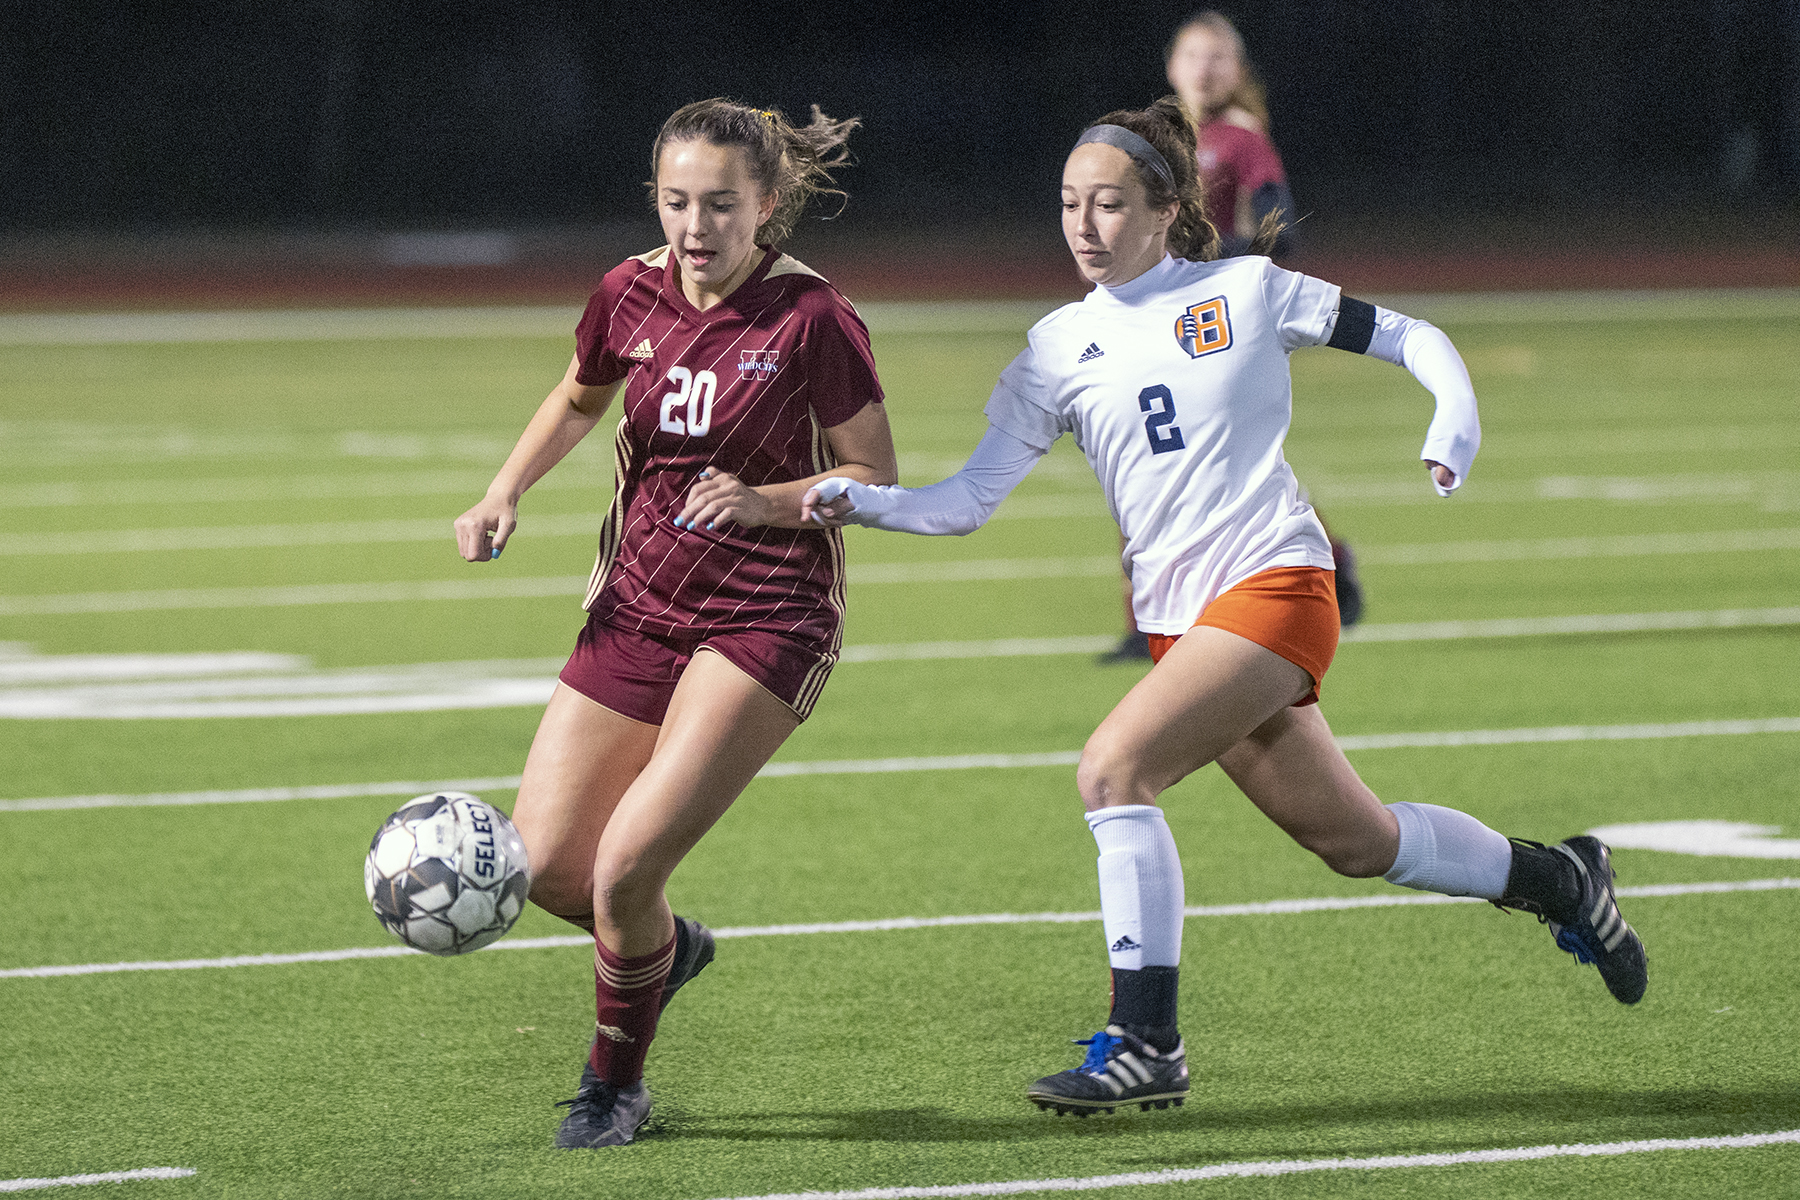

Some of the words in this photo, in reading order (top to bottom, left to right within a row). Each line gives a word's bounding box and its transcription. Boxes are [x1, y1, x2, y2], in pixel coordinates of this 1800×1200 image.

[628, 350, 655, 359] adidas
[1078, 350, 1105, 363] adidas
[1185, 295, 1233, 359] B
[740, 350, 780, 381] W
[660, 366, 717, 437] 20
[1138, 384, 1186, 455] 2
[465, 802, 495, 878] SELECT
